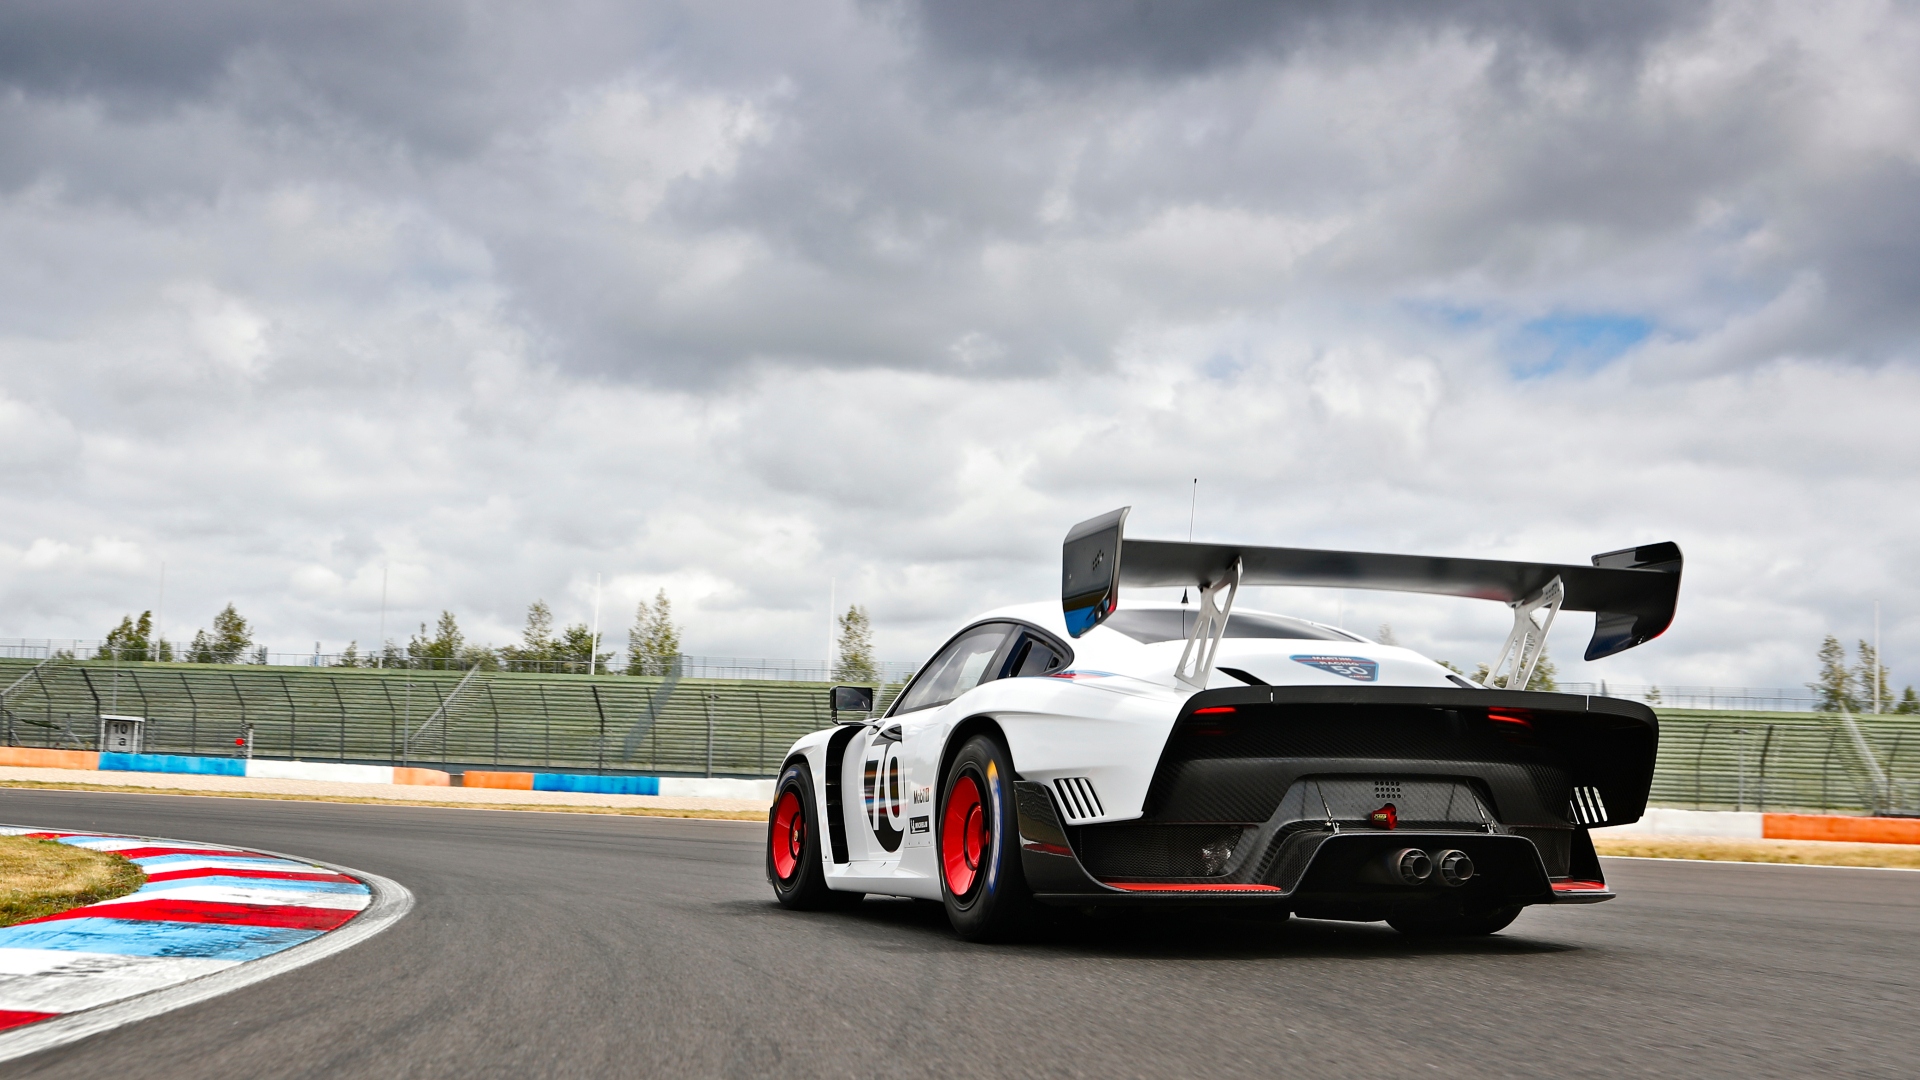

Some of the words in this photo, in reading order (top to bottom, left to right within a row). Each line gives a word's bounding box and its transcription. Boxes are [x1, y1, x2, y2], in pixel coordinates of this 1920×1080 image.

[1330, 666, 1368, 675] 50
[113, 724, 128, 734] 10
[119, 738, 126, 746] a
[867, 741, 905, 831] 70
